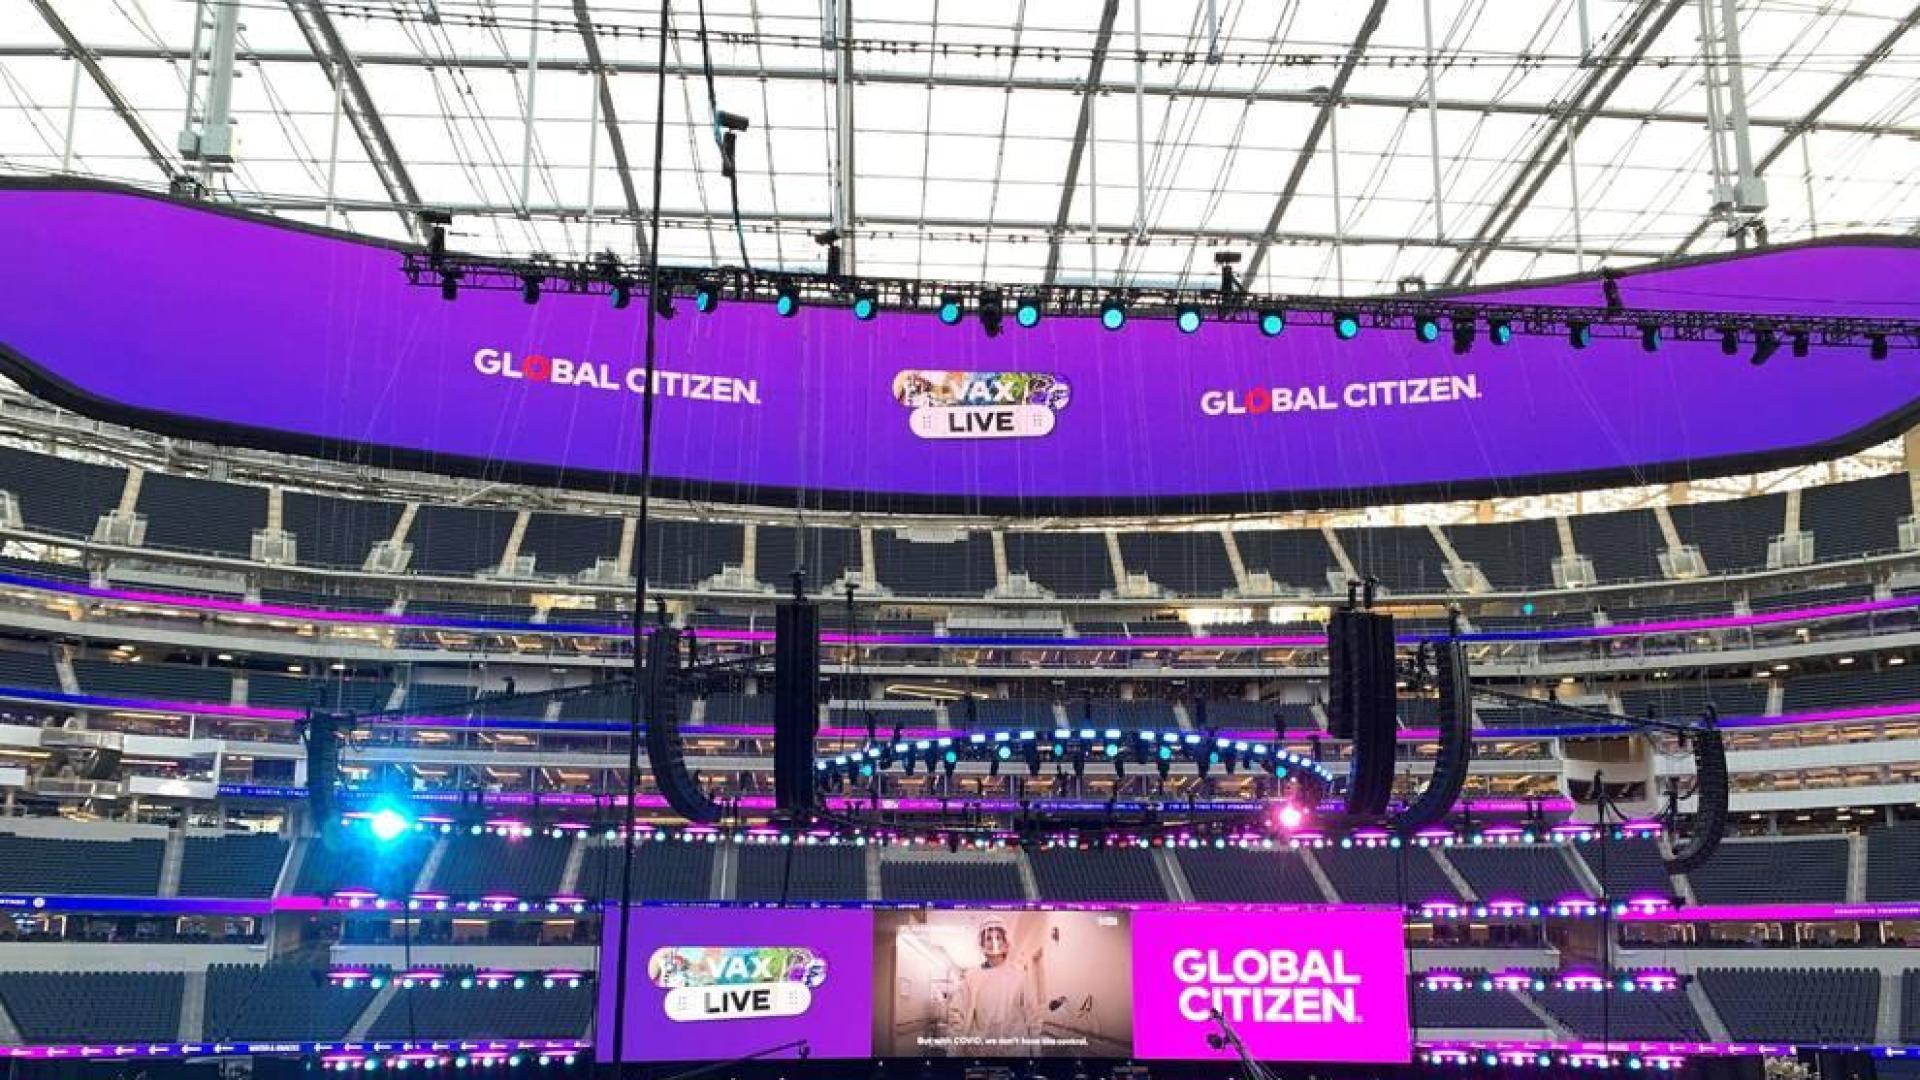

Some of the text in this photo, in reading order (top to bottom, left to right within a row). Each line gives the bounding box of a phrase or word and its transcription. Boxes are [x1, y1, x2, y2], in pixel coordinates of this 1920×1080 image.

[474, 348, 620, 390] GLOBAL
[947, 380, 1016, 401] VAX
[1200, 385, 1339, 416] GLOBAL
[949, 411, 1014, 432] LIVE
[706, 955, 774, 979] VAX
[1173, 948, 1362, 984] GLOBAL
[703, 989, 771, 1014] LIVE
